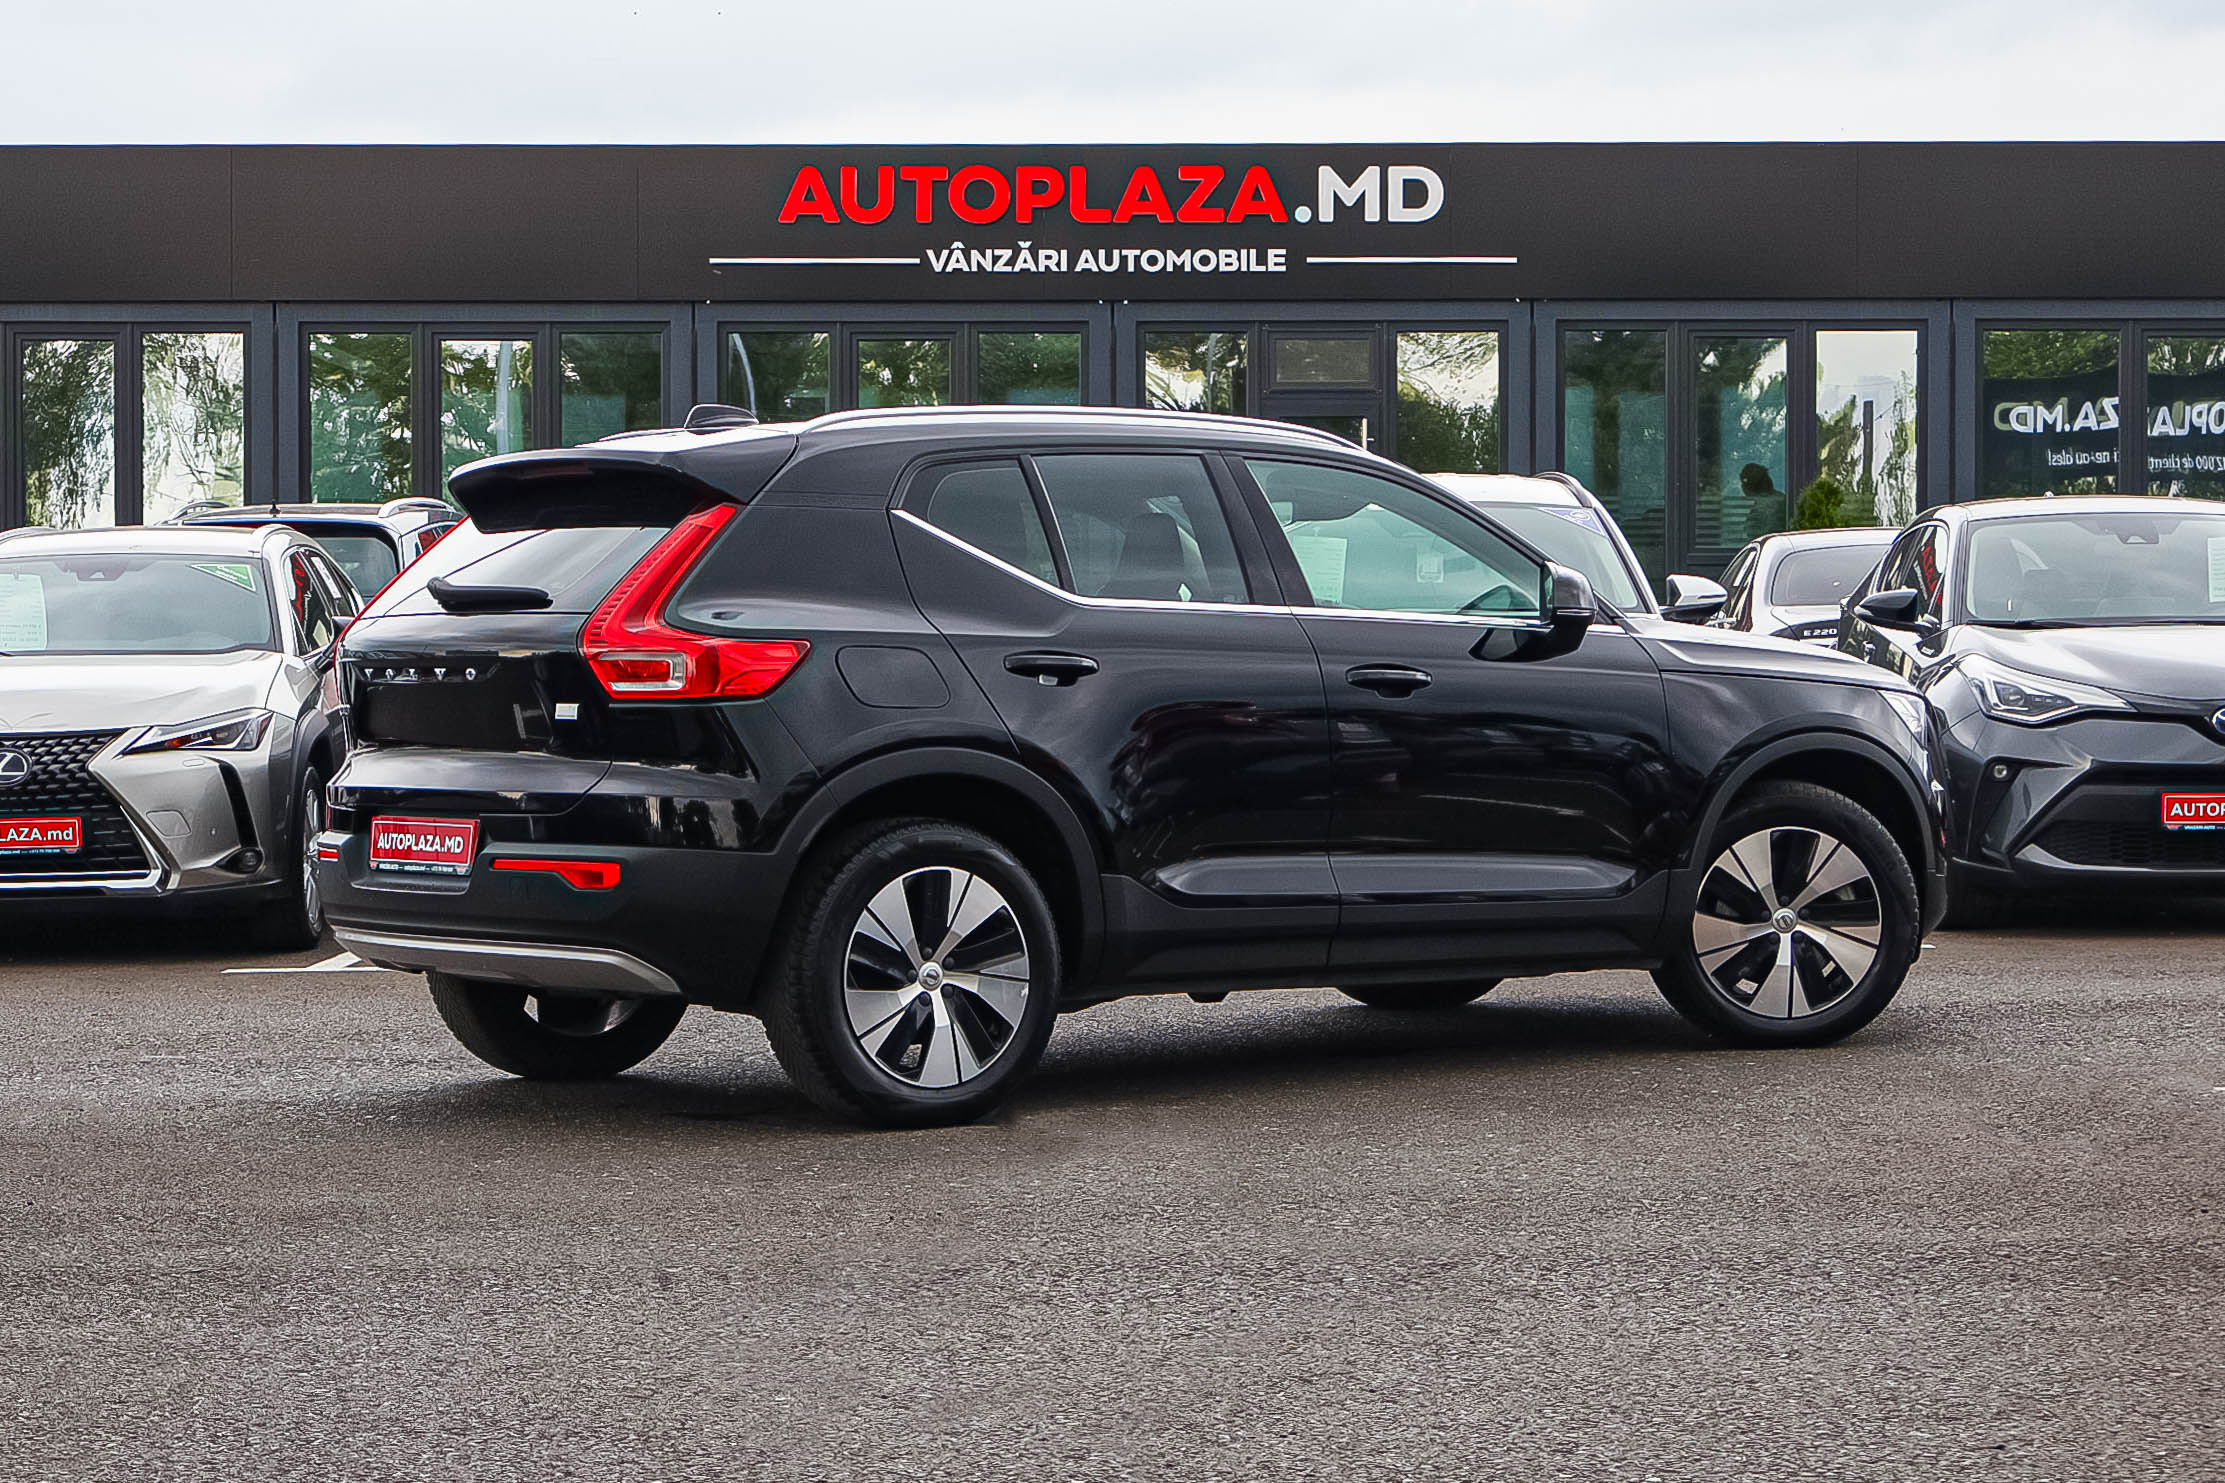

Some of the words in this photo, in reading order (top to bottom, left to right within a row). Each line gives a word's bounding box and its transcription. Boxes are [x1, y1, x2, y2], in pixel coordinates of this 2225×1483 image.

[778, 165, 1444, 224] AUTOPLAZA.MD
[926, 241, 1068, 273] VÂNZĂRI
[1073, 248, 1287, 274] AUTOMOBILE
[1813, 628, 1838, 636] 220
[377, 832, 464, 854] AUTOPLAZA.MD
